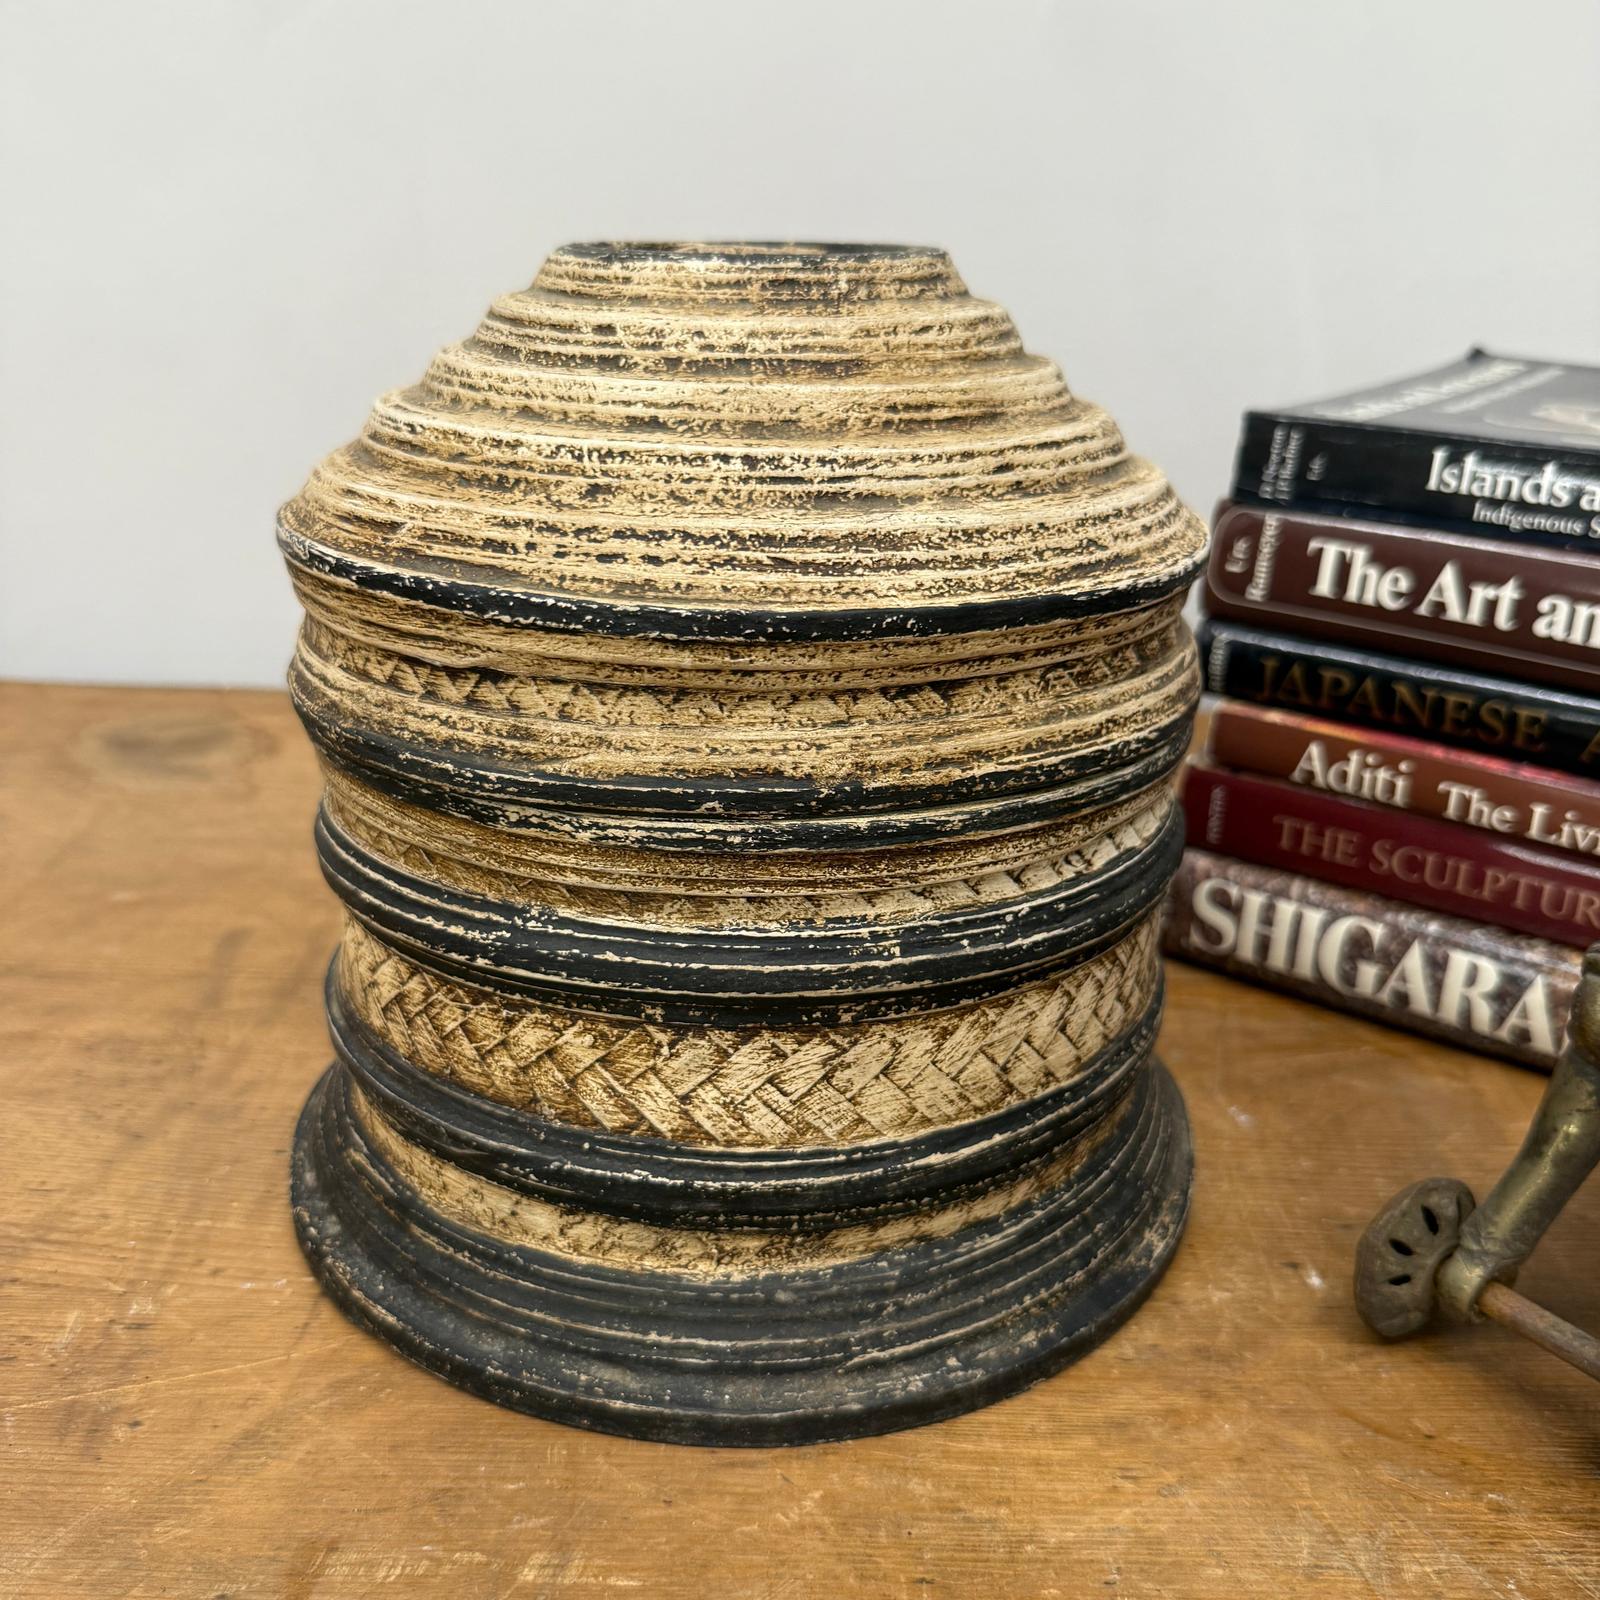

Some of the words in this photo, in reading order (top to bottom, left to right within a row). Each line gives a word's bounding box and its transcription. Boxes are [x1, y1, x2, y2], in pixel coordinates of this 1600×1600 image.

[1425, 446, 1573, 508] Islands
[1473, 499, 1586, 536] Indigenous
[1307, 536, 1416, 611] The
[1413, 559, 1526, 632] Art
[1256, 655, 1548, 751] JAPANESE
[1289, 740, 1416, 808] Aditi
[1437, 780, 1520, 833] The
[1273, 814, 1363, 867] THE
[1369, 838, 1600, 929] SCULPTUR
[1188, 878, 1570, 1057] SHIGARA
